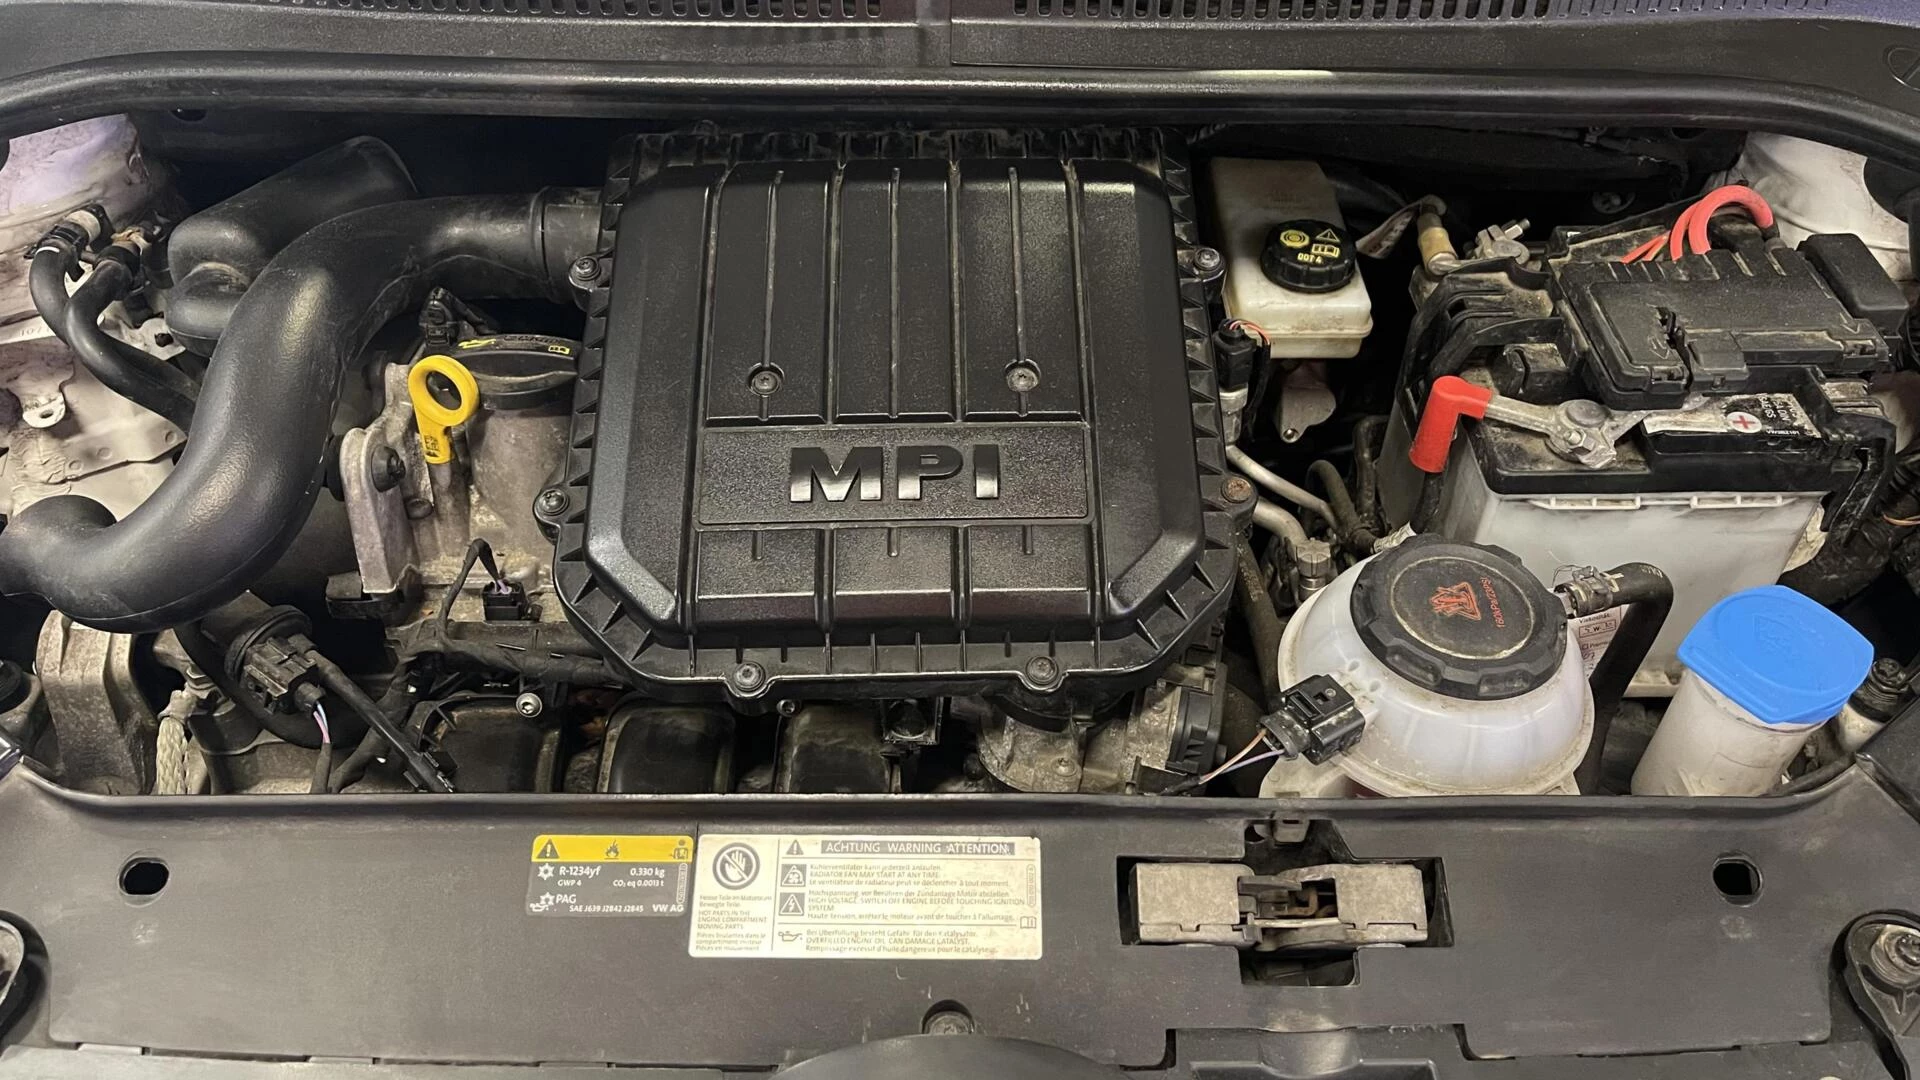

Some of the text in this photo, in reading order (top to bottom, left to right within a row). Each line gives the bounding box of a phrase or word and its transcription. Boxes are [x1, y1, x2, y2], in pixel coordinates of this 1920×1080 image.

[1297, 252, 1323, 265] DOT 4
[790, 444, 999, 502] MPI
[825, 842, 881, 853] ACHTUNG
[887, 842, 941, 853] WARNING
[946, 842, 1010, 854] ATTENTION
[559, 865, 601, 878] R-1234yf
[630, 867, 666, 878] 0.330 kg
[557, 879, 575, 887] GWP
[637, 879, 659, 887] 0.0013
[556, 894, 577, 904] PAG
[569, 904, 583, 912] SAE
[652, 904, 684, 912] VW AG
